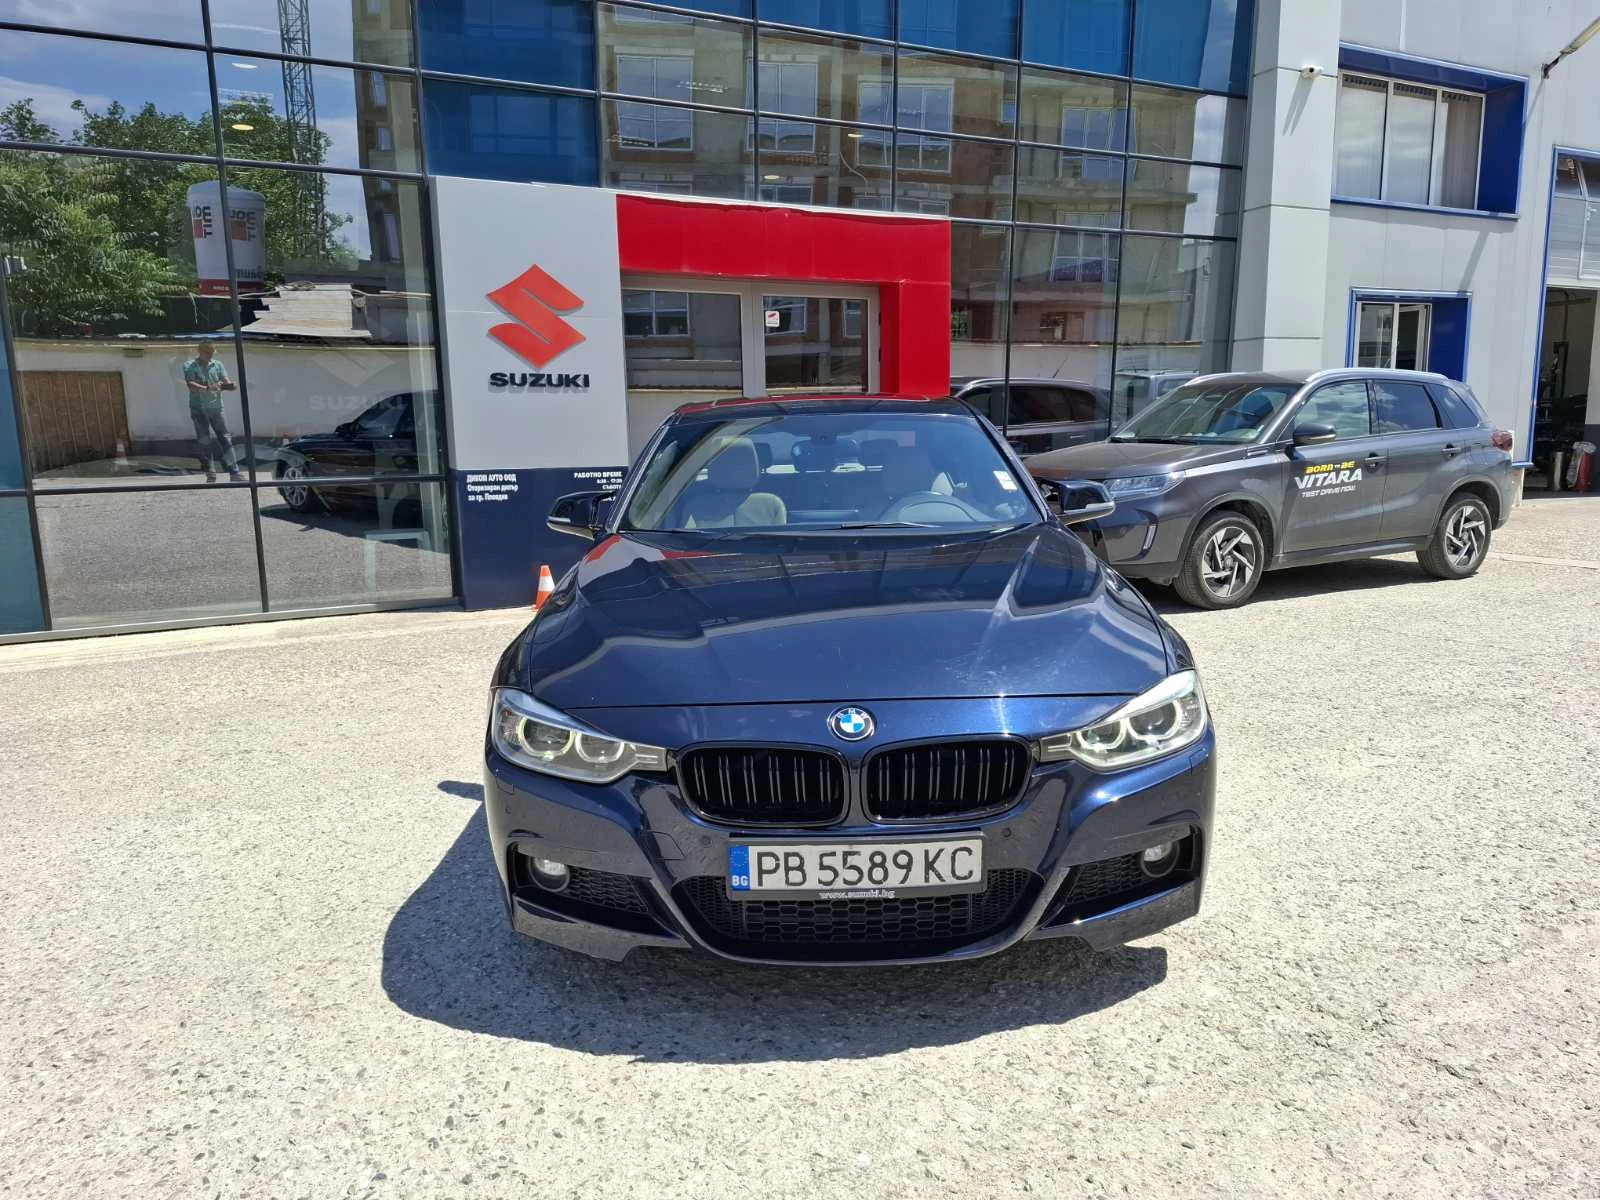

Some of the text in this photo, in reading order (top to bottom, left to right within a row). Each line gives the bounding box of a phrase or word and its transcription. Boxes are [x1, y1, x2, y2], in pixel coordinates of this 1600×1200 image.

[489, 372, 590, 388] SUZUKI
[1305, 463, 1334, 474] BORN
[1340, 461, 1355, 469] BE
[573, 471, 602, 479] РАБОТНО
[1294, 468, 1362, 489] VITARA
[1301, 489, 1320, 498] TEST
[1320, 487, 1339, 495] DRIVE
[756, 846, 974, 888] PB 5589 KC
[731, 875, 749, 887] BG
